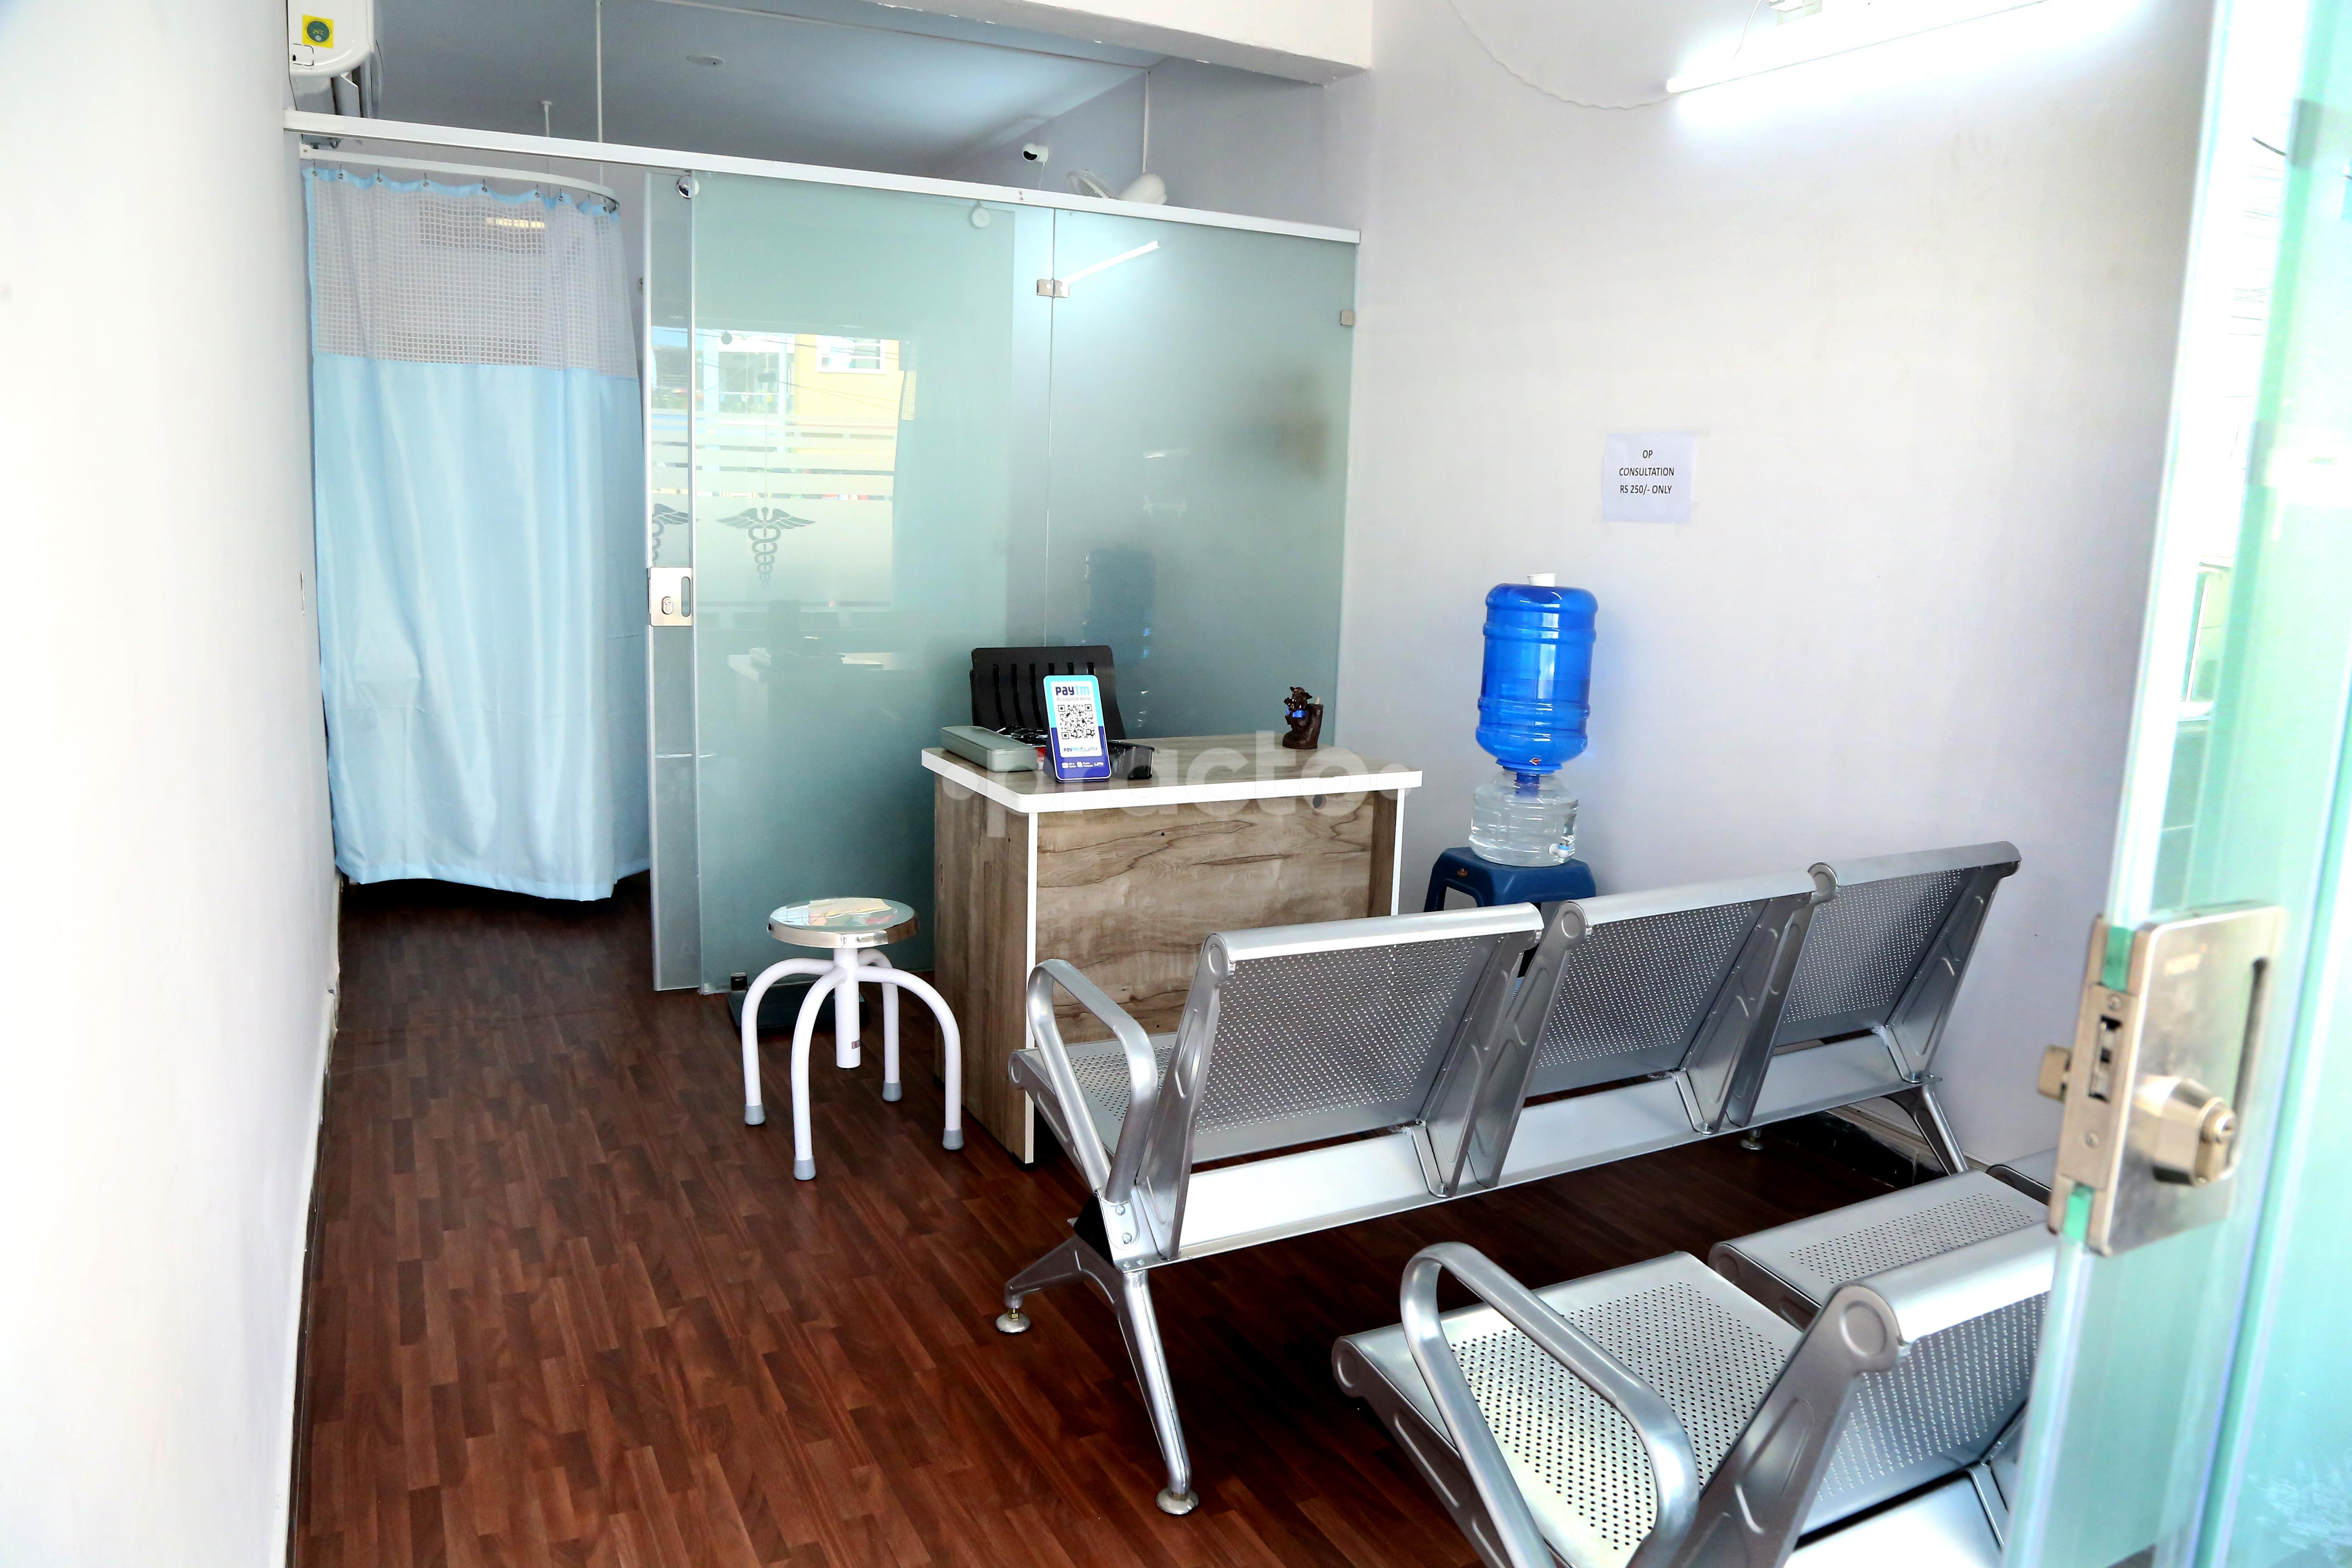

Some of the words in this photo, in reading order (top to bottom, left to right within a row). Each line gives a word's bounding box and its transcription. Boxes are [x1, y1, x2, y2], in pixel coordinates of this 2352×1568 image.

[1642, 450, 1653, 459] OP
[1619, 467, 1675, 476] CONSULTATION
[1620, 485, 1628, 493] RS
[1630, 484, 1650, 495] 250/-
[1652, 485, 1672, 494] ONLY
